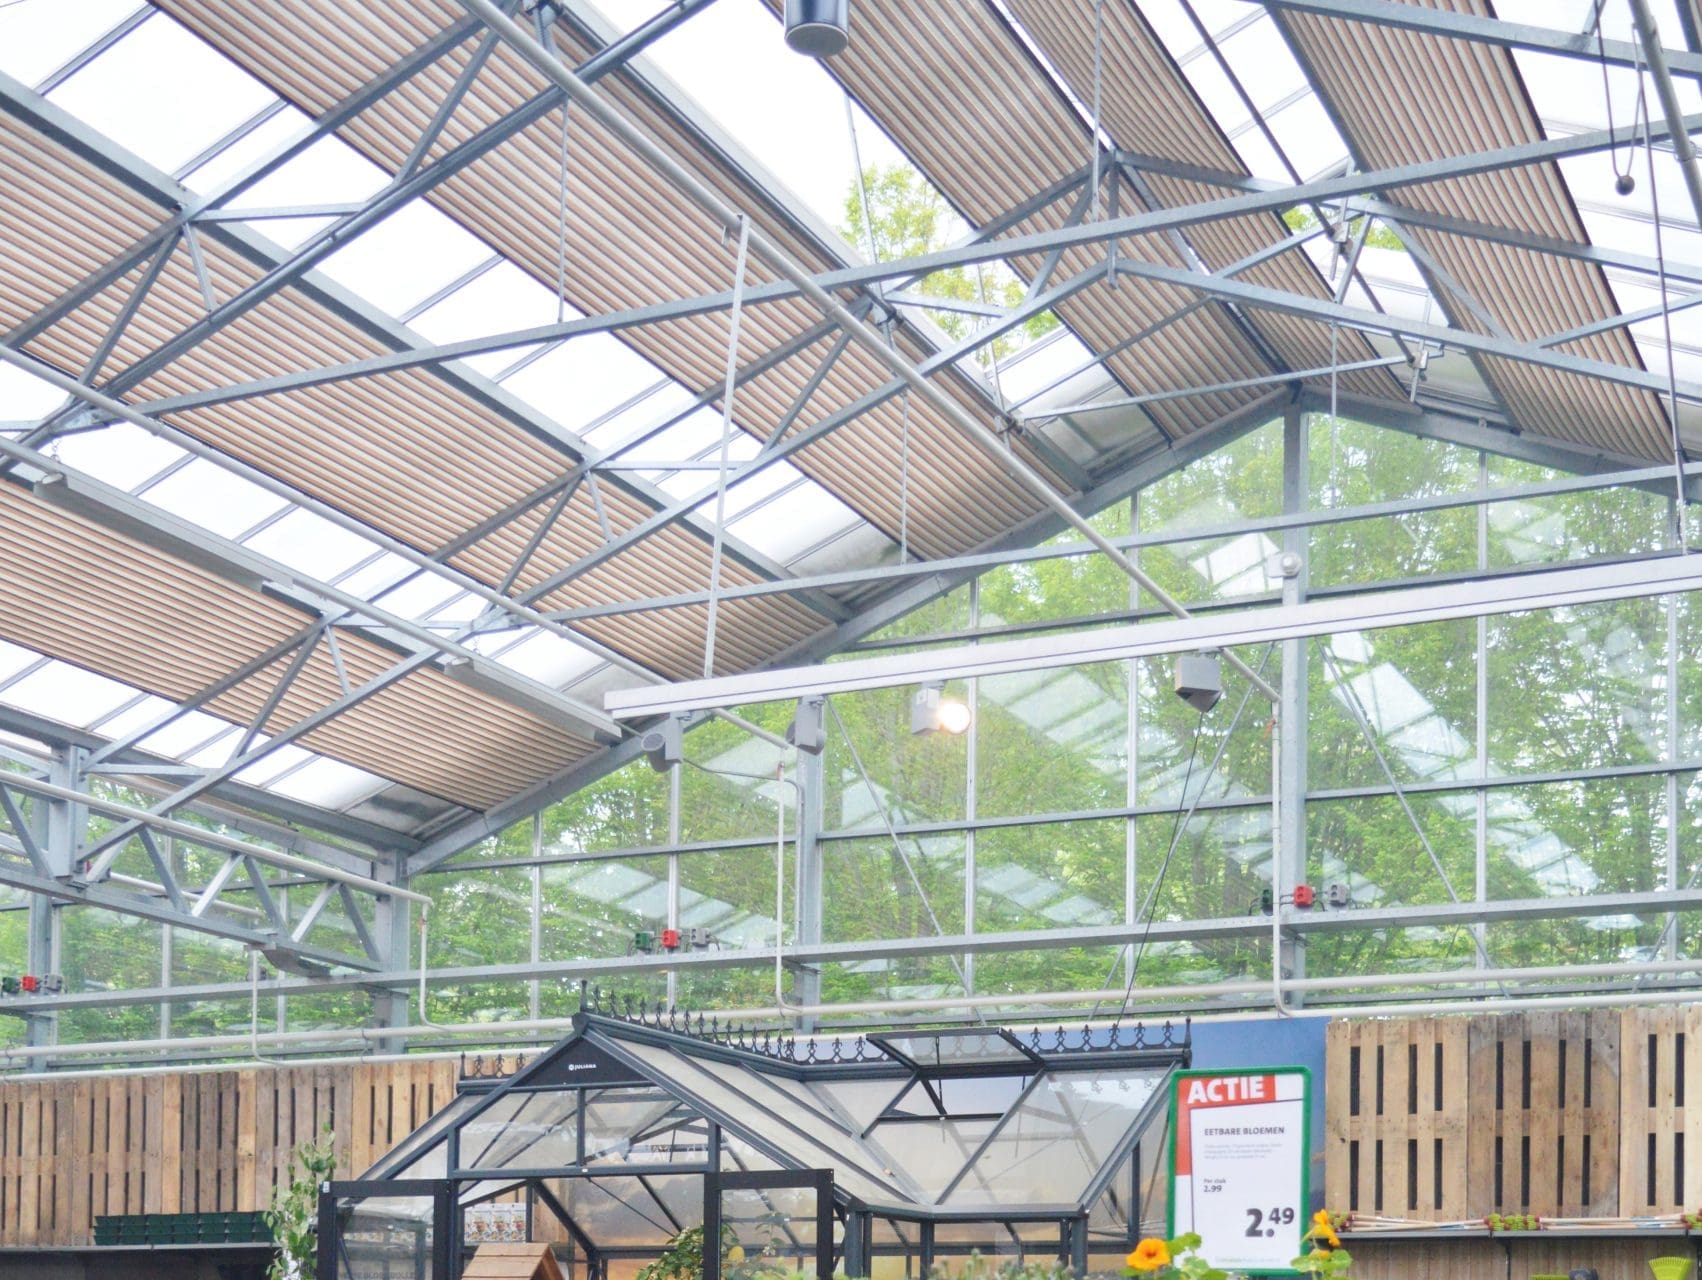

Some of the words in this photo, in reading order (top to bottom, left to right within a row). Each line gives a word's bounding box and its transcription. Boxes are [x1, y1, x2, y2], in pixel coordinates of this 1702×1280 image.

[1188, 1076, 1264, 1104] ACTIE
[1204, 1127, 1241, 1136] EETBARE
[1243, 1126, 1285, 1135] BLOEMEN
[1245, 1207, 1294, 1237] 2.49
